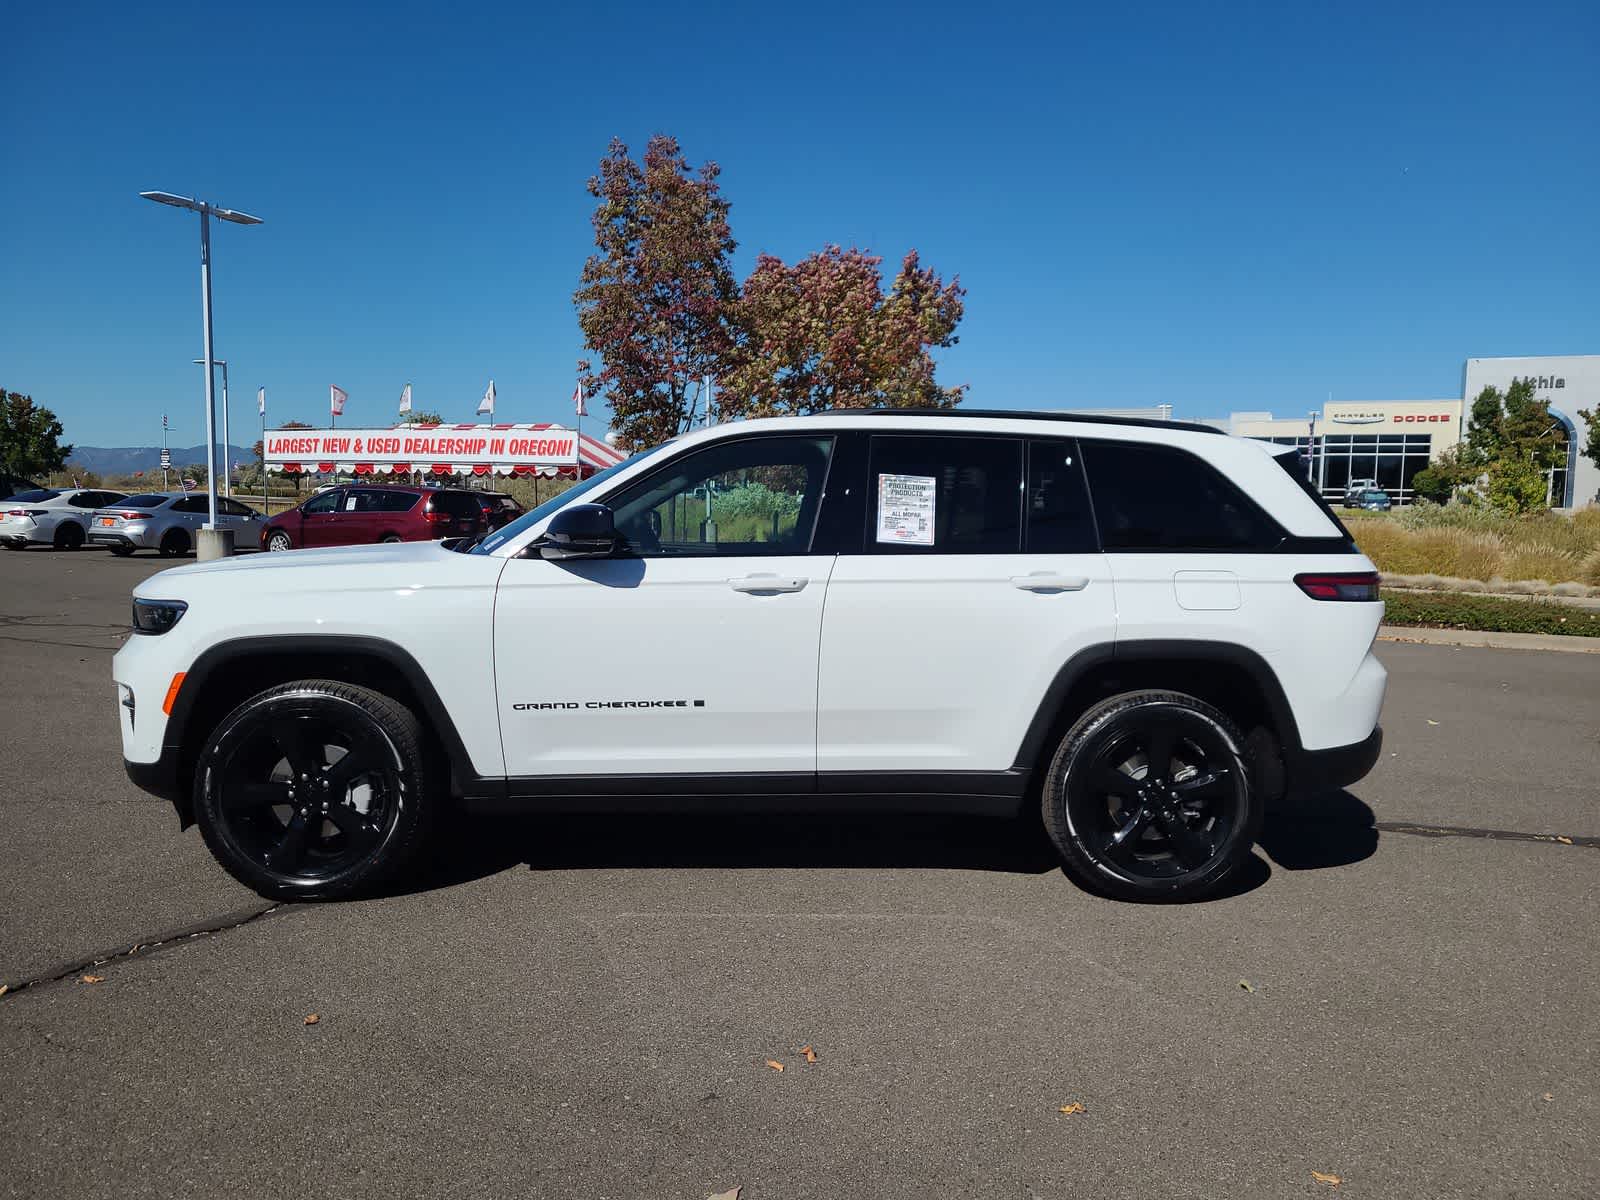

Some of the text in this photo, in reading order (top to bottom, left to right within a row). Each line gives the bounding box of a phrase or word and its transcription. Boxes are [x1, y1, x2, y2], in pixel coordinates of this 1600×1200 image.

[1512, 375, 1566, 389] thia
[1393, 415, 1450, 423] DODGE
[268, 438, 573, 457] LARGEST NEW & USED DEALERSHIP IN OREGON!
[888, 483, 926, 491] PROTECTION
[513, 700, 687, 710] GRAND CHEROKEE
